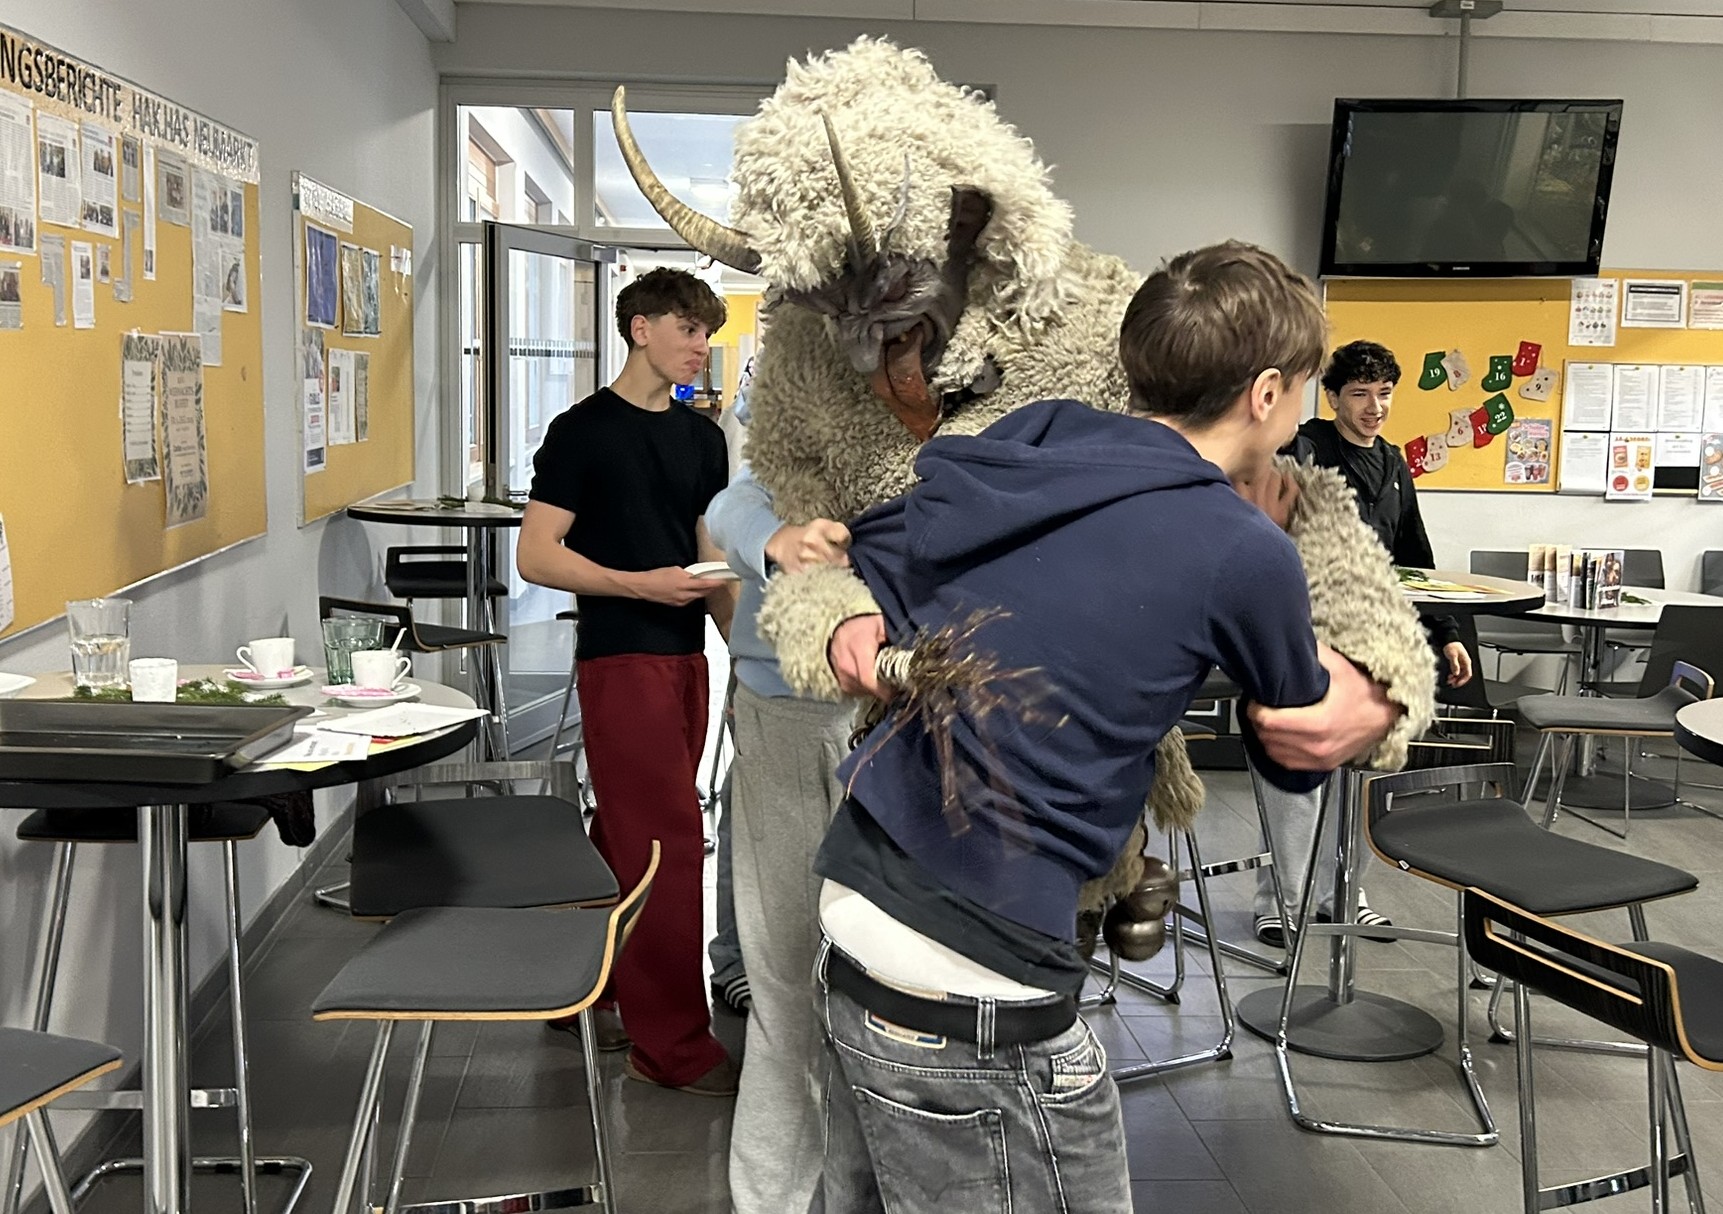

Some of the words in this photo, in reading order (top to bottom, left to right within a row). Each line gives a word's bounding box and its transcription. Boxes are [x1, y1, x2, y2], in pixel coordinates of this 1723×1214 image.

[1429, 367, 1441, 378] 19
[1495, 372, 1506, 381] 16
[1494, 411, 1507, 423] 22
[1457, 426, 1464, 435] 6
[1430, 452, 1441, 462] 13
